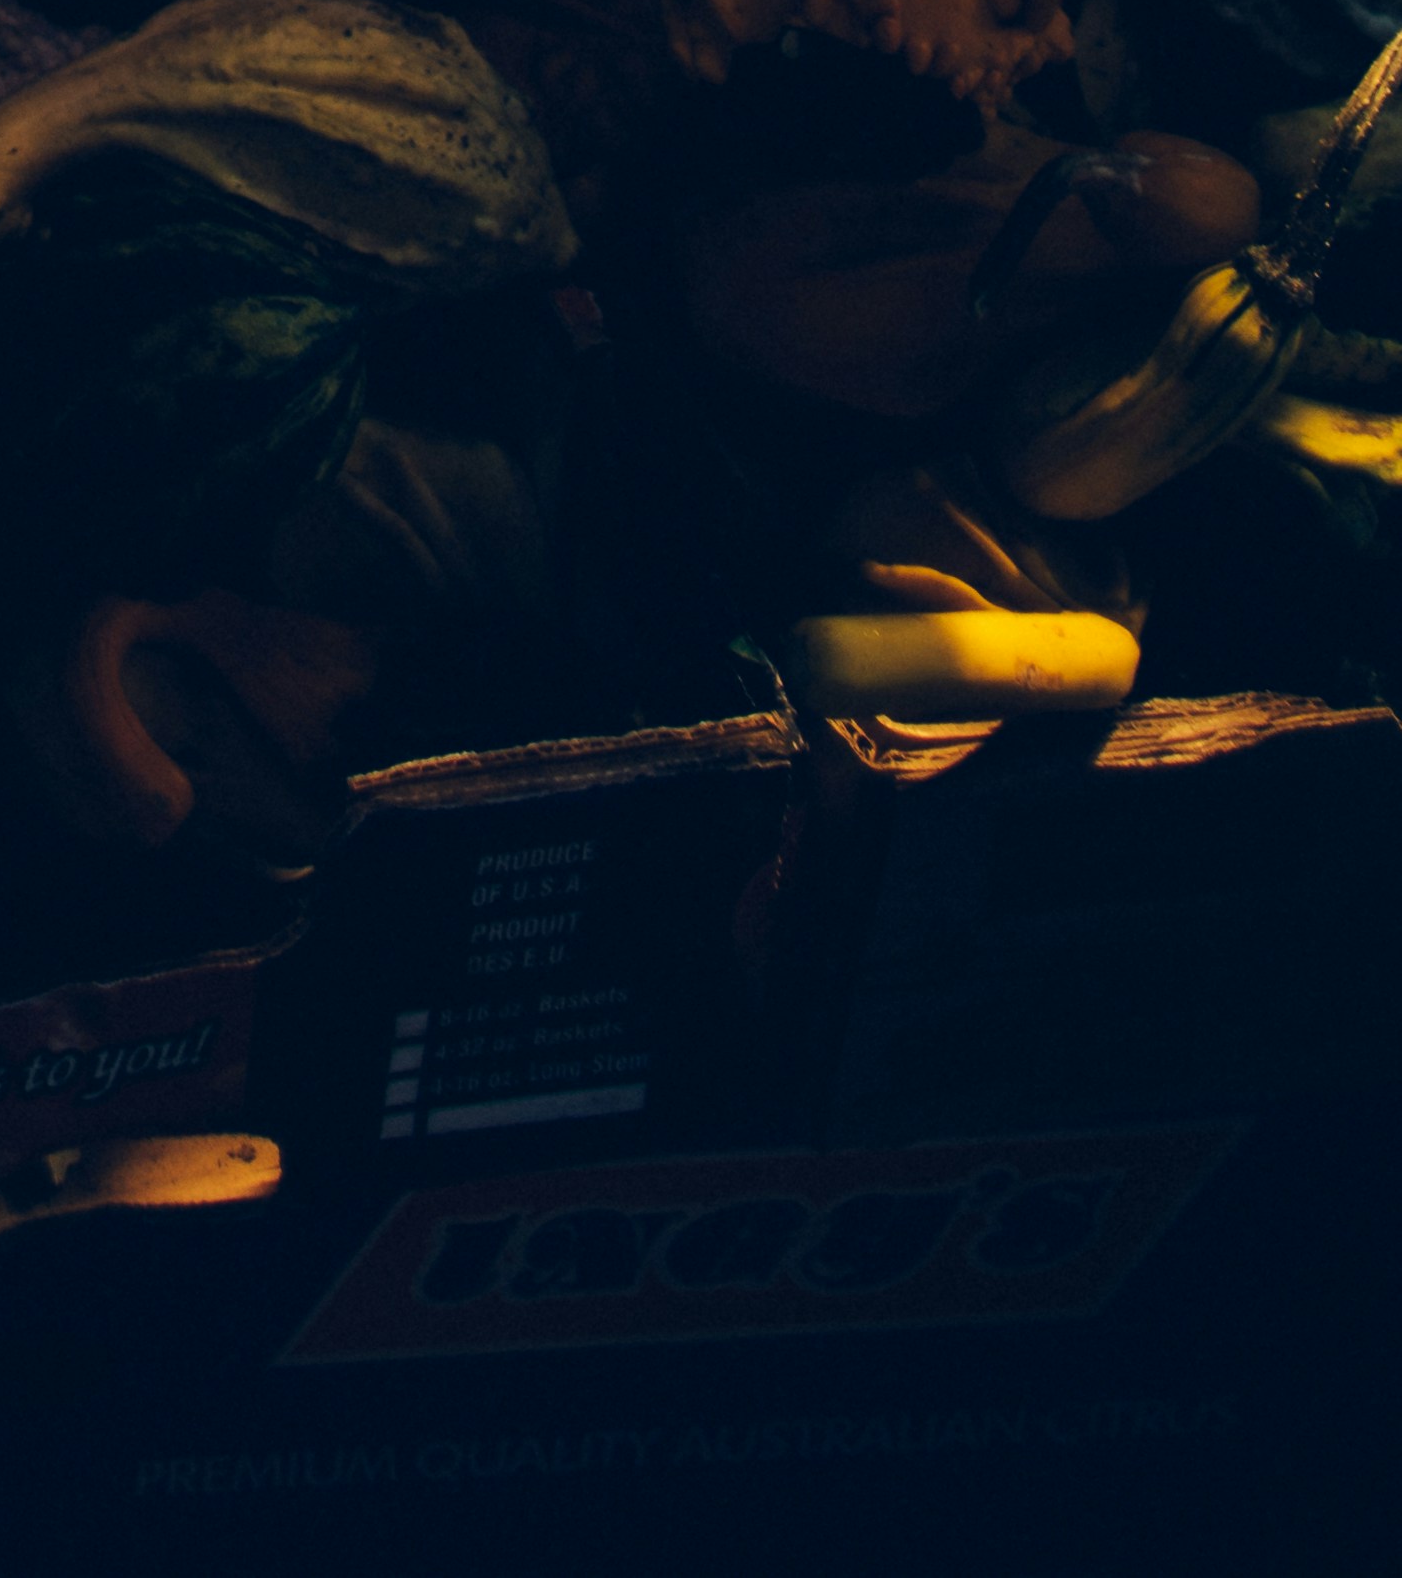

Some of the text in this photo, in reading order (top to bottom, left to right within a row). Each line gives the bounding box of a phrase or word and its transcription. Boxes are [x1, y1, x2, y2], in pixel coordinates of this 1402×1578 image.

[476, 839, 598, 877] PRODUCE
[470, 882, 503, 909] OF
[469, 910, 584, 945] PRODUIT
[467, 949, 516, 975] DES
[537, 986, 630, 1015] Baskets
[532, 1020, 625, 1046] Baskets
[23, 1047, 77, 1090] to
[81, 1021, 215, 1105] you!
[133, 1443, 399, 1499] PREMIUM
[414, 1426, 662, 1485] QUALITY
[675, 1403, 1026, 1465] AUSTRALIAN
